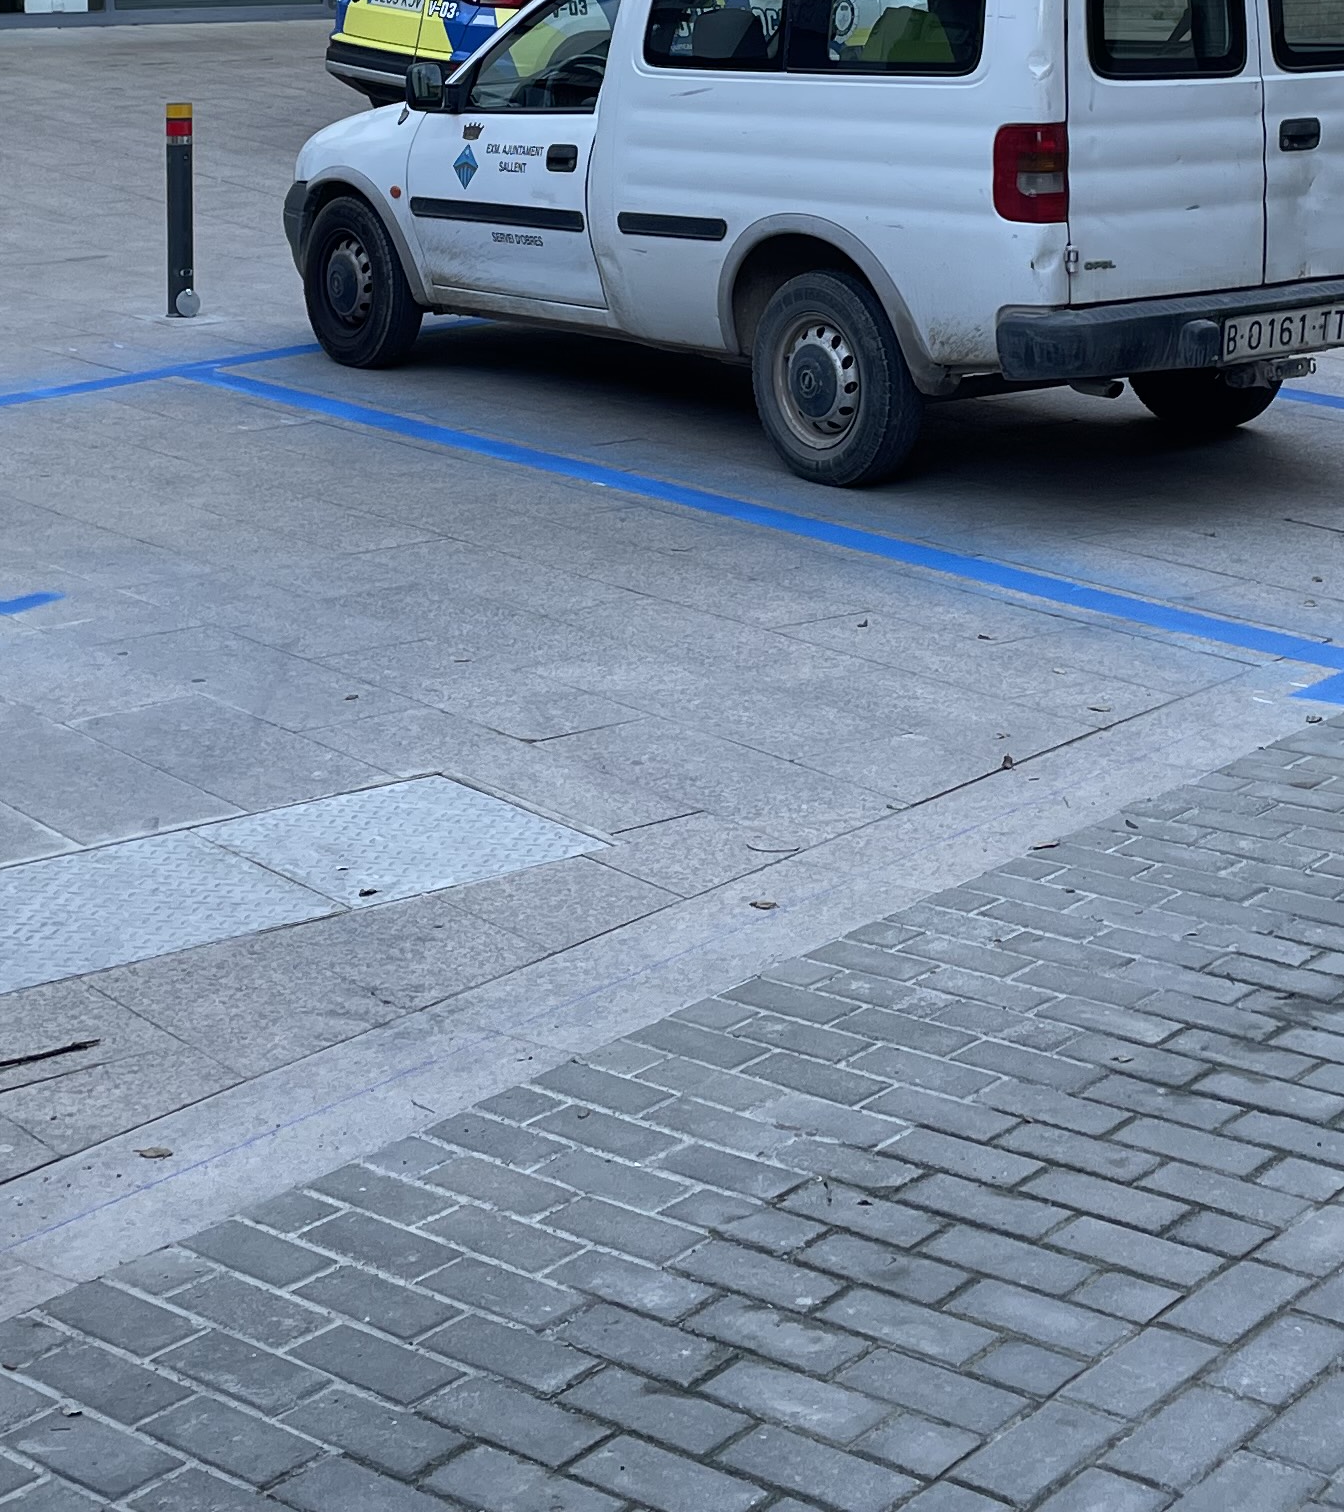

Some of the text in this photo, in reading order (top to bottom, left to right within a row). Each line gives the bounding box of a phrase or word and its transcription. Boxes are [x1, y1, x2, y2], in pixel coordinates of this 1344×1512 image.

[428, 0, 456, 19] V-03
[502, 144, 544, 157] AJUNTAMENT
[498, 161, 527, 173] SALLENT
[1084, 260, 1116, 270] OPEL
